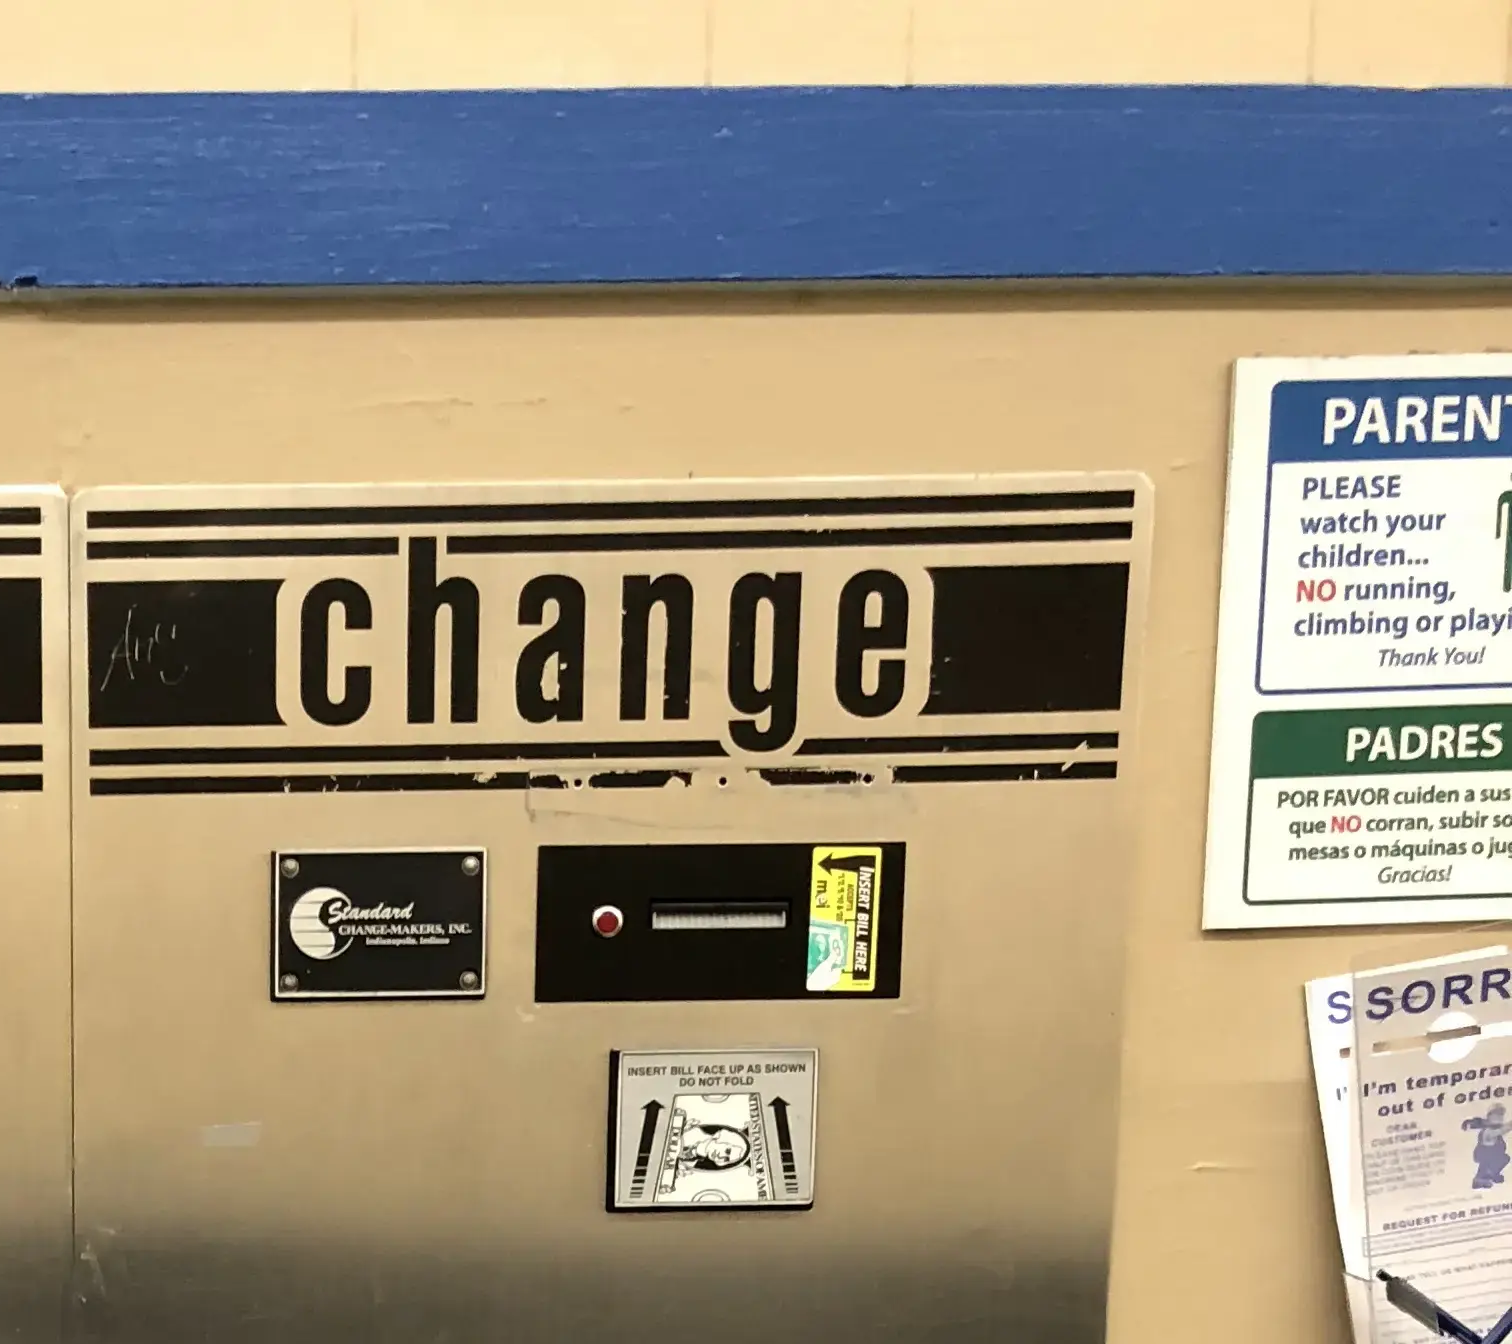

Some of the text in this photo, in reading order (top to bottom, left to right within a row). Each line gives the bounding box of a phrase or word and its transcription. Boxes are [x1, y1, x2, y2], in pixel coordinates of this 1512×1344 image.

[1323, 394, 1512, 446] PAREN
[1302, 475, 1401, 500] PLEASE
[1301, 509, 1446, 538] watch your
[1298, 543, 1429, 569] children...
[1296, 576, 1456, 605] NO running,
[1294, 610, 1408, 639] climbing
[1416, 614, 1444, 633] or
[300, 537, 909, 752] change
[1379, 646, 1486, 668] Thank You!
[1346, 721, 1504, 763] PADRES
[1277, 785, 1511, 809] POR FAVOR cuiden a sus
[1289, 818, 1326, 837] que
[1330, 815, 1362, 833] NO
[1366, 816, 1434, 833] corran,
[1439, 812, 1489, 830] subir
[1288, 844, 1349, 861] mesas
[1354, 845, 1367, 859] o
[1371, 838, 1467, 861] máquinas
[1471, 841, 1485, 856] o
[1377, 865, 1452, 885] Gracias!
[858, 866, 875, 910] INSERT
[328, 901, 414, 924] Standard
[856, 912, 869, 937] BILL
[449, 923, 472, 934] INC.
[854, 941, 868, 972] HERE
[627, 1063, 806, 1076] INSERT BILL FACE UP AS SHOWN
[679, 1076, 754, 1087] DO NOT FOLD
[1363, 1077, 1397, 1097] I'm
[1378, 1099, 1414, 1117] out
[1423, 1092, 1445, 1109] of
[1383, 1214, 1438, 1231] REQUEST
[1442, 1210, 1466, 1221] FOR
